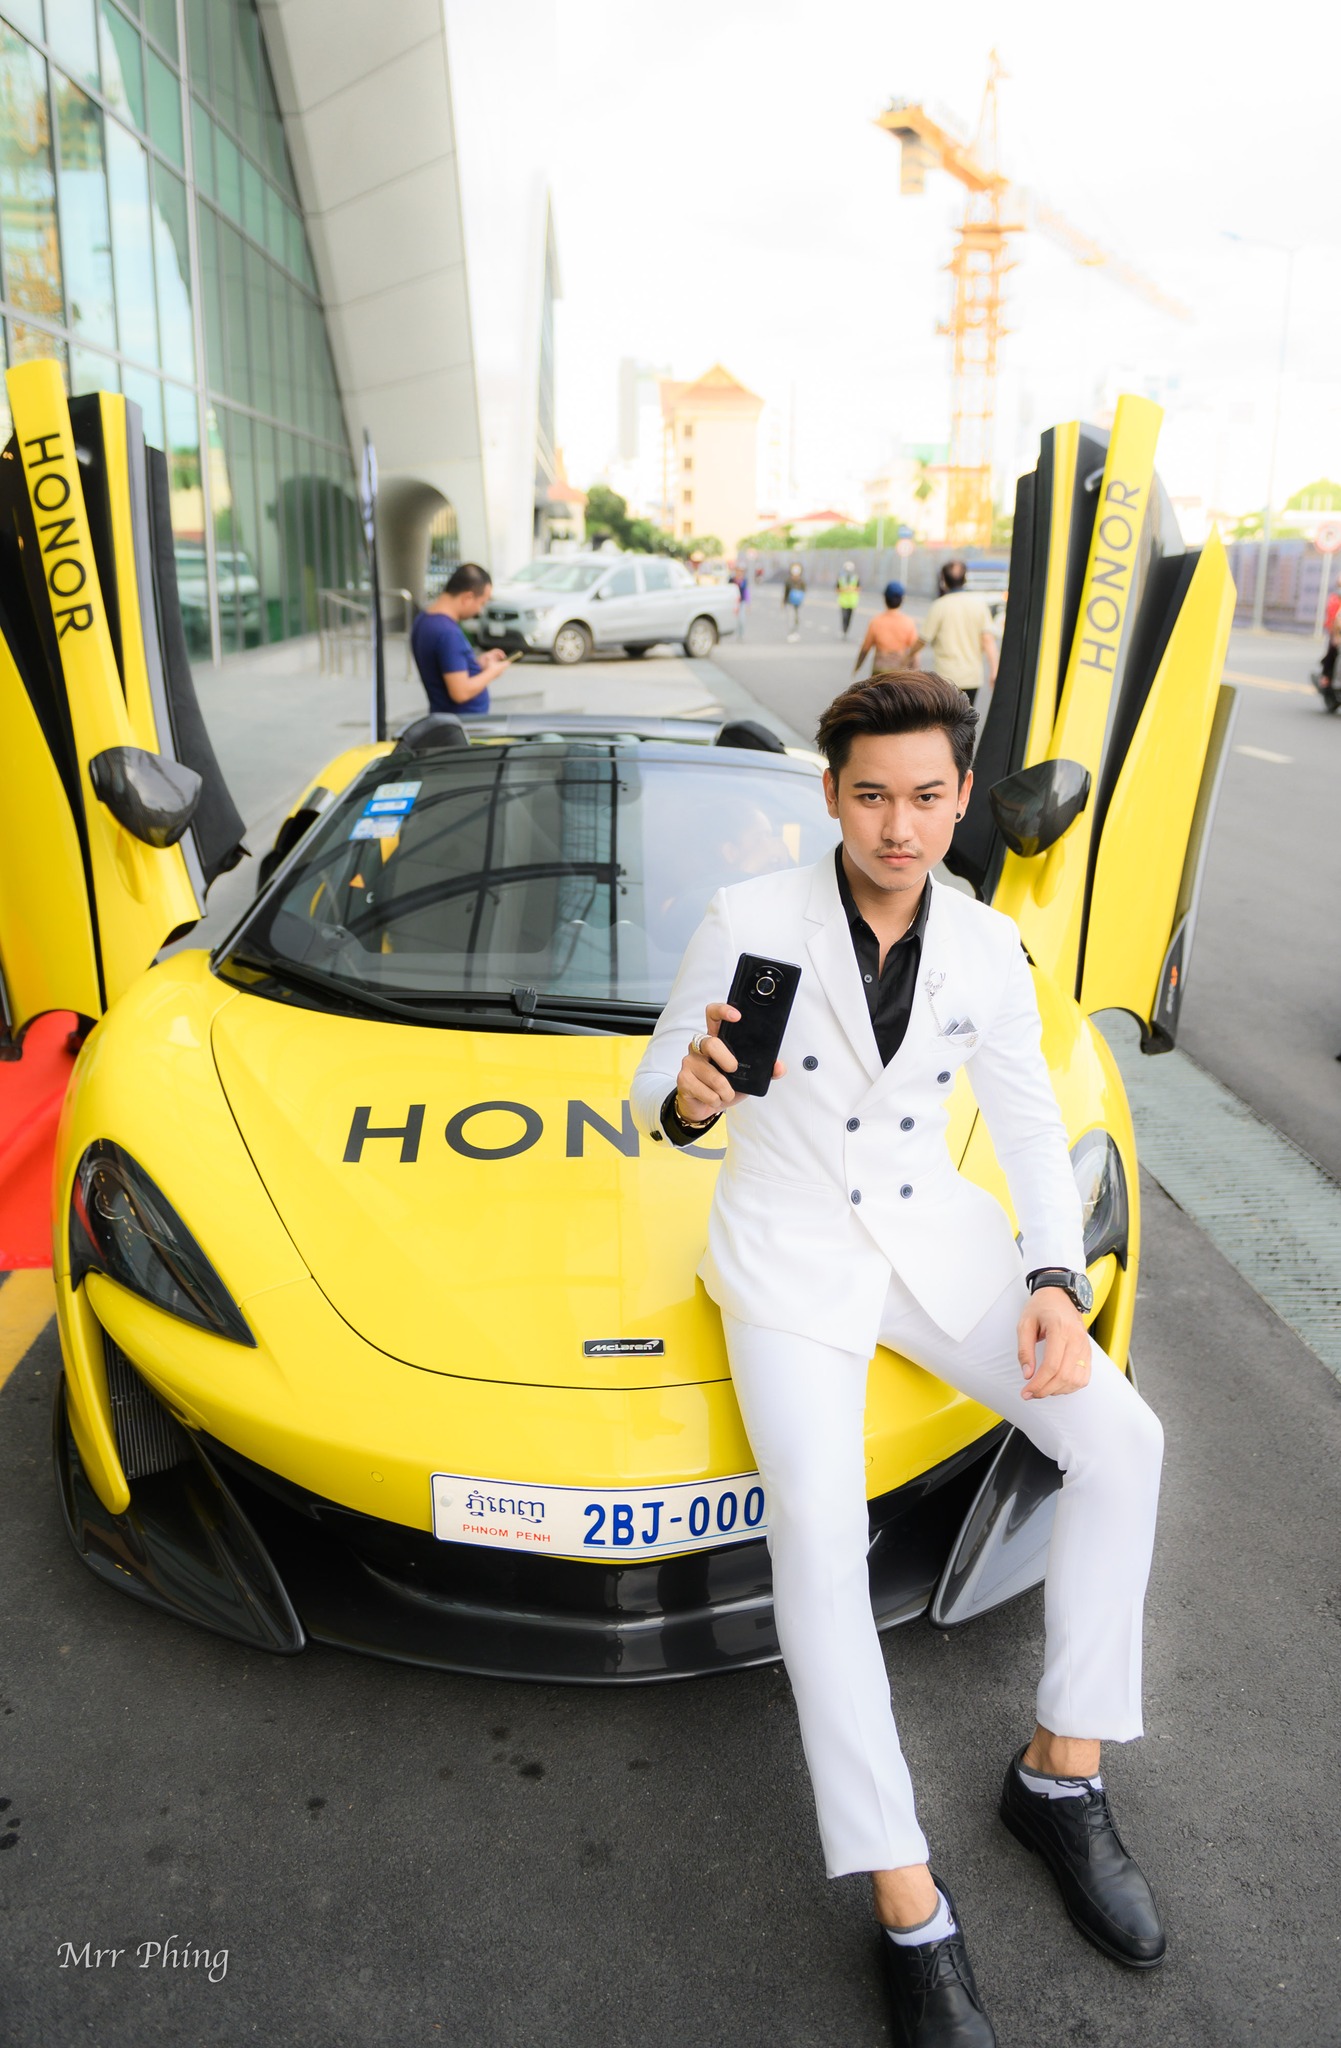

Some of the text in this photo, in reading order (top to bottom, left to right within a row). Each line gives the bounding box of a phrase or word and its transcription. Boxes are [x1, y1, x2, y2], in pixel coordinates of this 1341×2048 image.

[24, 433, 94, 640] HONOR
[1080, 480, 1141, 673] HONOR
[342, 1100, 727, 1163] HON
[590, 1341, 656, 1352] McLaren
[462, 1523, 551, 1543] PHNOM PENH
[465, 1490, 545, 1523] ភ្នំពេញ
[583, 1486, 765, 1546] 2BJ-000
